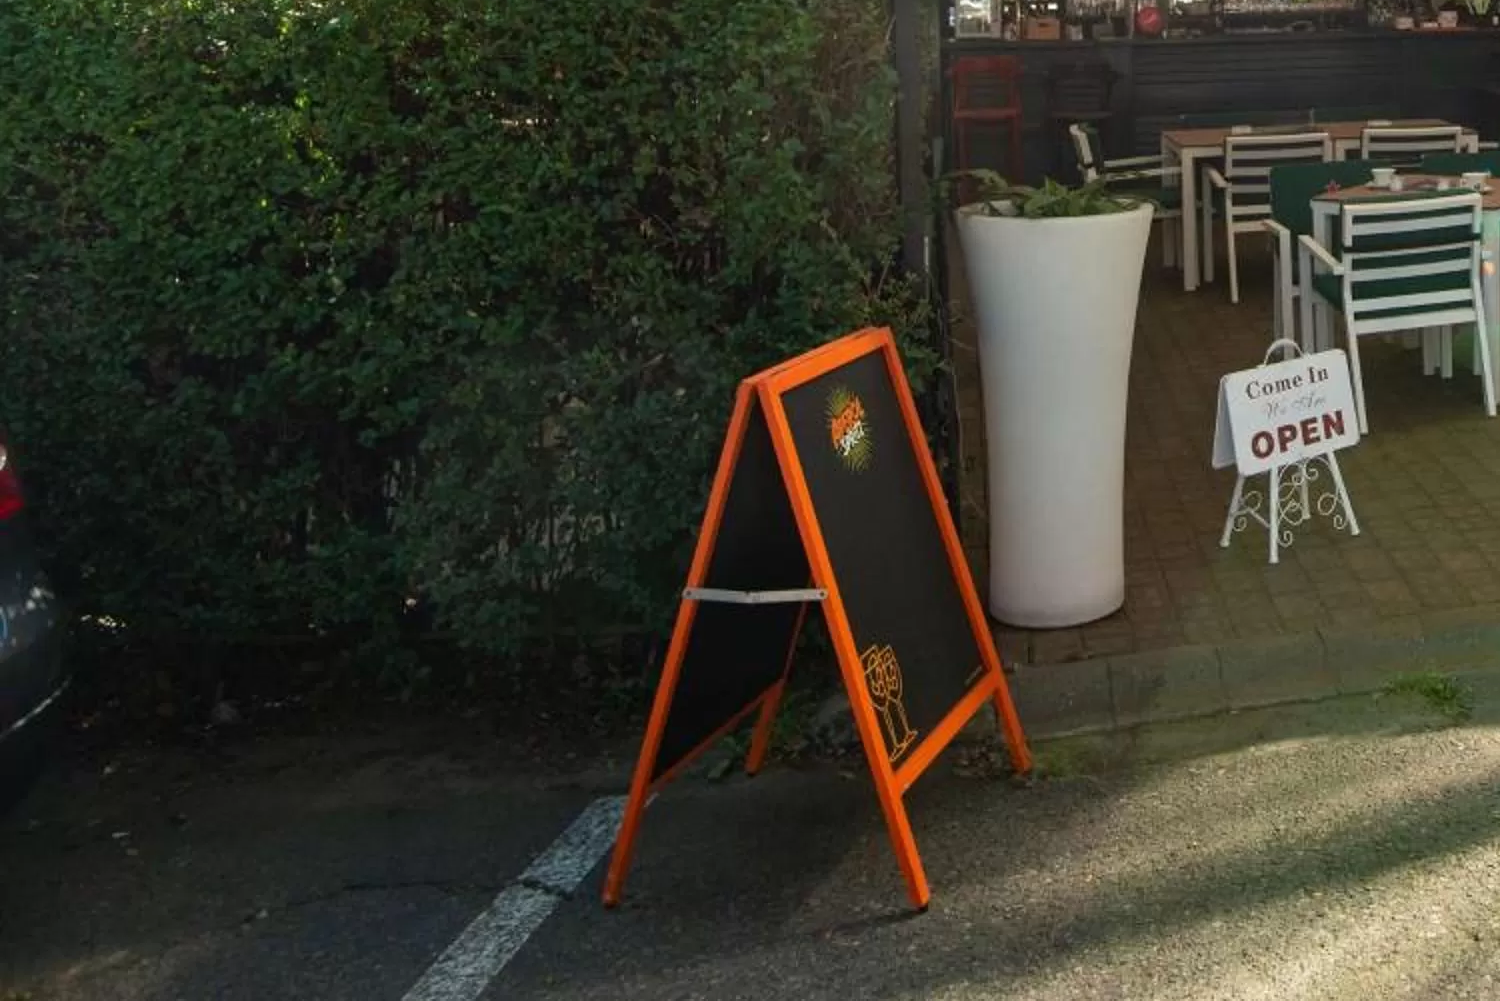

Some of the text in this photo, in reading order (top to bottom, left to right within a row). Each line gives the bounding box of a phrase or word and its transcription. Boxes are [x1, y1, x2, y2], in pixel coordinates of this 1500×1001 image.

[1246, 366, 1329, 399] Come In
[1252, 410, 1345, 459] OPEN
